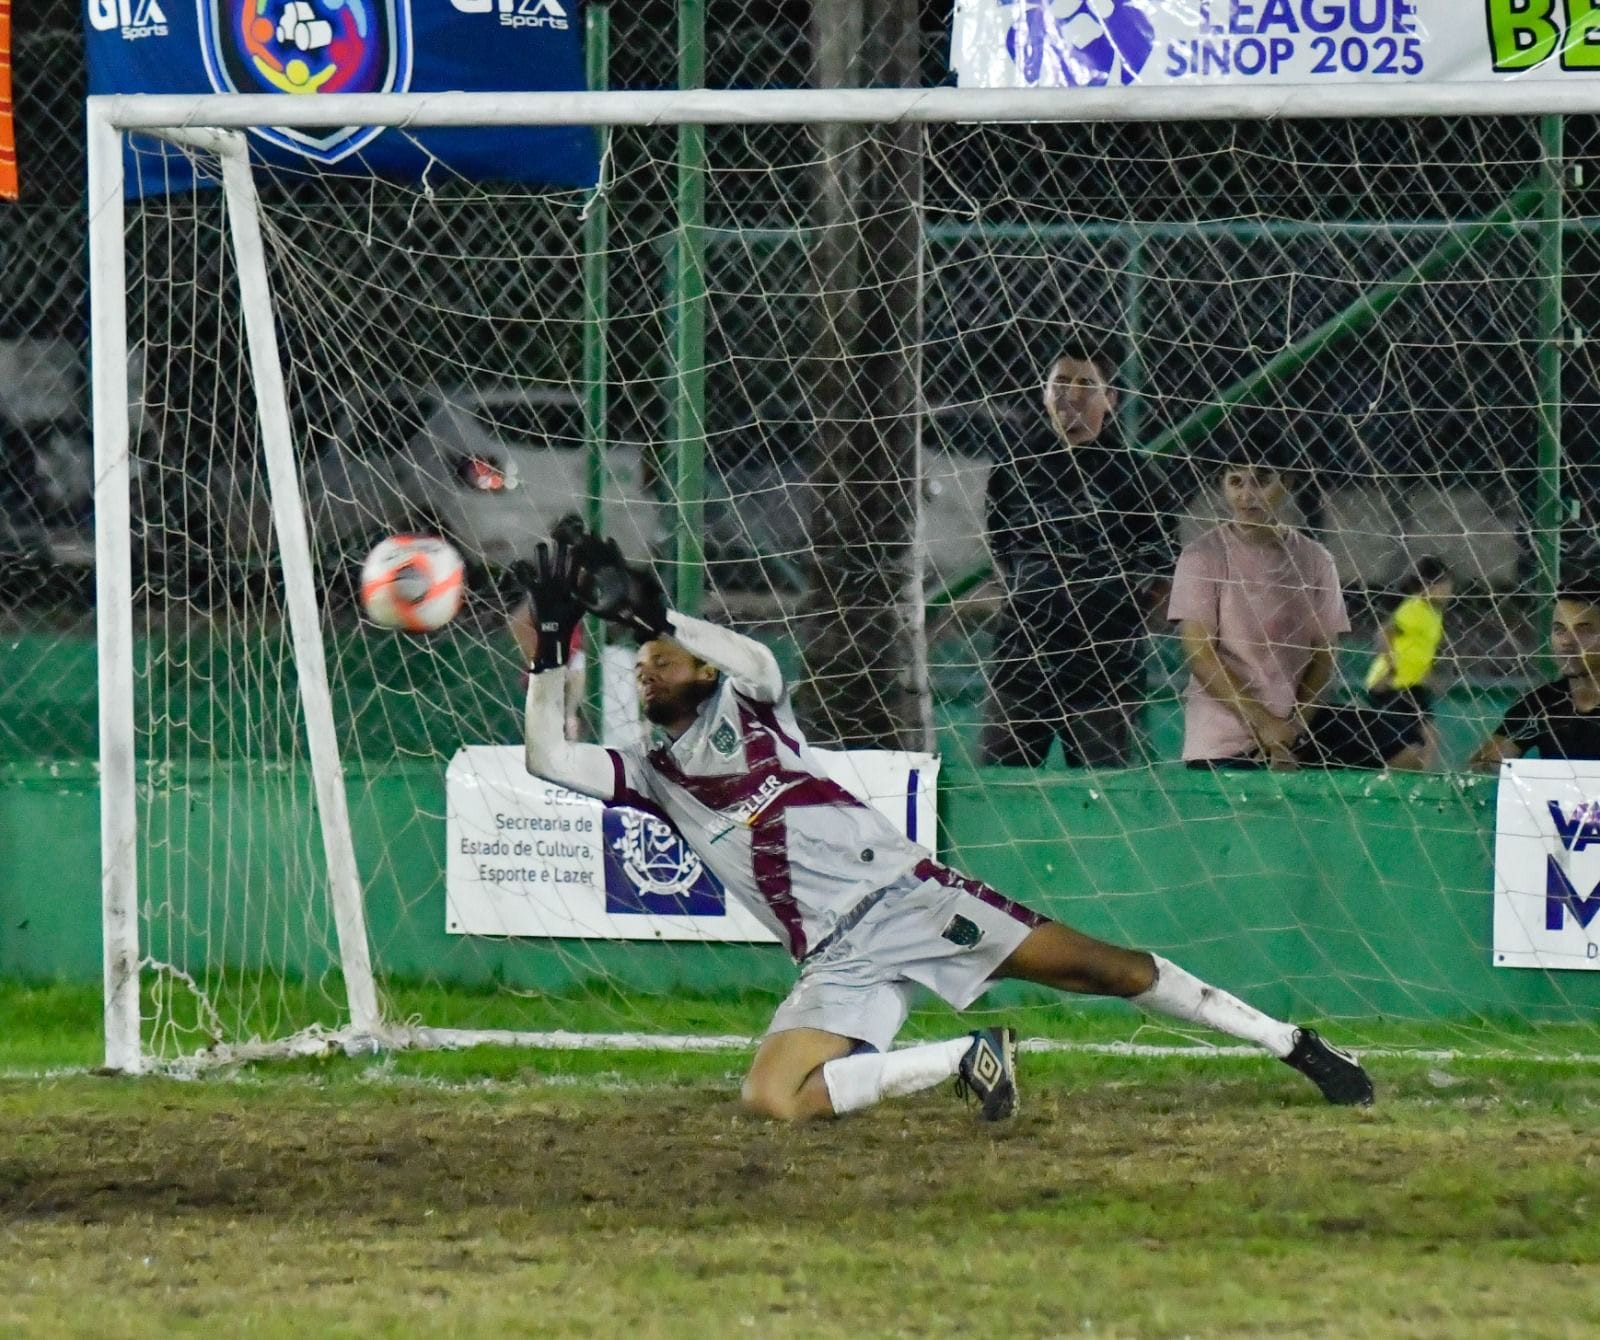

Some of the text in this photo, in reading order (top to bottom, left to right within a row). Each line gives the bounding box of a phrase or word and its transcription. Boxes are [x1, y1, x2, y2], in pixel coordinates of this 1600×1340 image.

[499, 12, 569, 30] Sports
[1200, 0, 1417, 34] LEAGUE
[1165, 37, 1424, 77] SINOP 2025
[495, 813, 593, 832] Secretaria de
[461, 838, 594, 861] Estado de Cultura,
[480, 864, 594, 885] Esporte e Lazer
